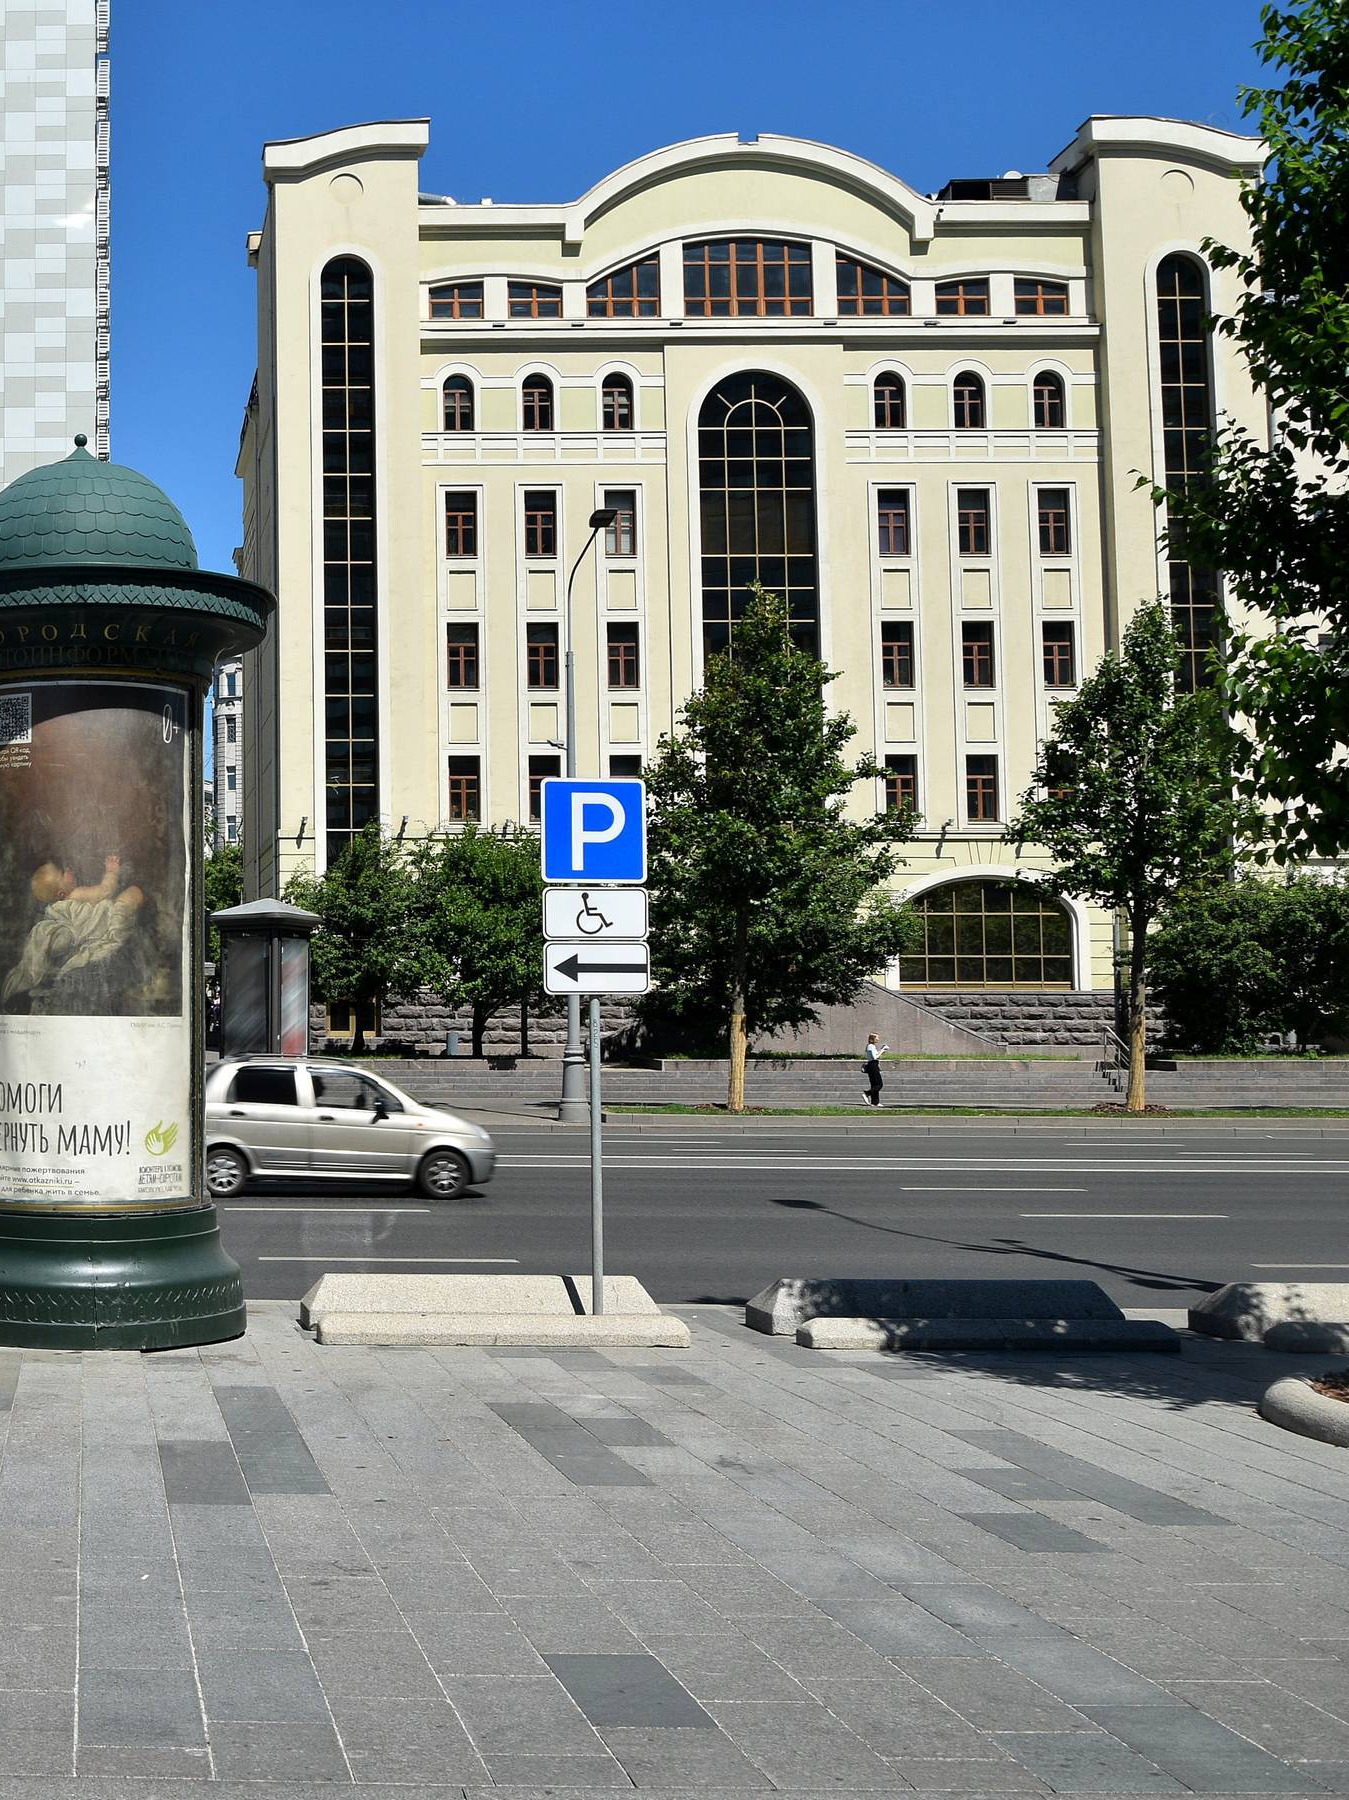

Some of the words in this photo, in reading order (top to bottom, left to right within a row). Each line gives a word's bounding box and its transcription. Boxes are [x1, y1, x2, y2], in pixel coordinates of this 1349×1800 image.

[571, 792, 626, 871] P
[57, 1120, 130, 1156] МАМУ!
[21, 1166, 85, 1175] пожертвования
[12, 1176, 73, 1185] www.otkazniki.ru
[46, 1188, 66, 1196] жить
